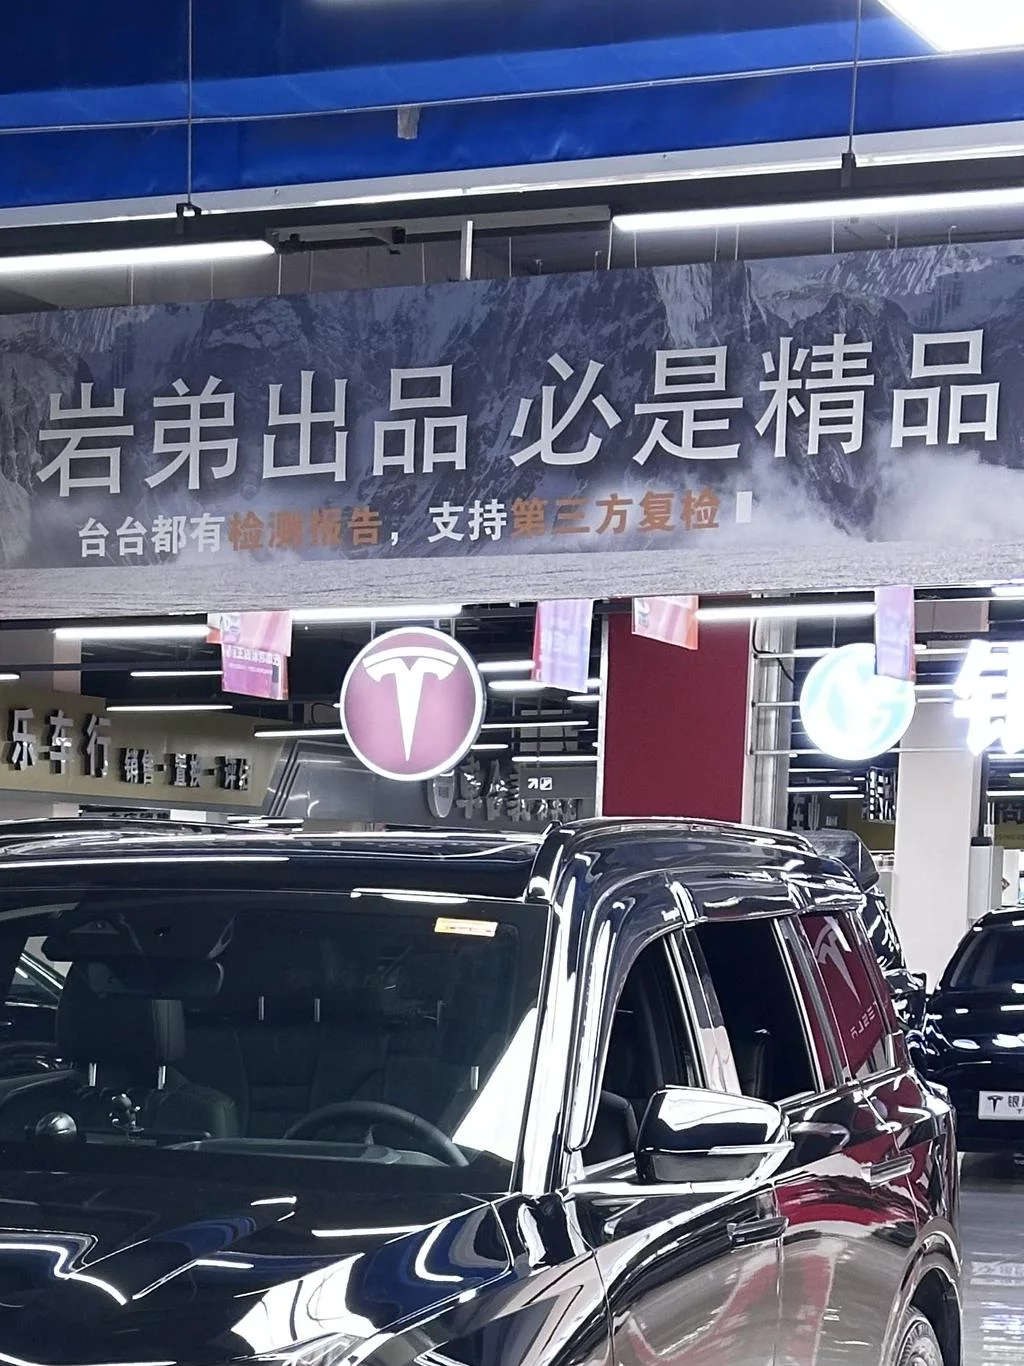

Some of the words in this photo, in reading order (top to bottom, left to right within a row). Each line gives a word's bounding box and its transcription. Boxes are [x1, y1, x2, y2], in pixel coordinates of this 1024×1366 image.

[36, 364, 468, 497] 岩弟出品
[509, 329, 1000, 467] 必是精品
